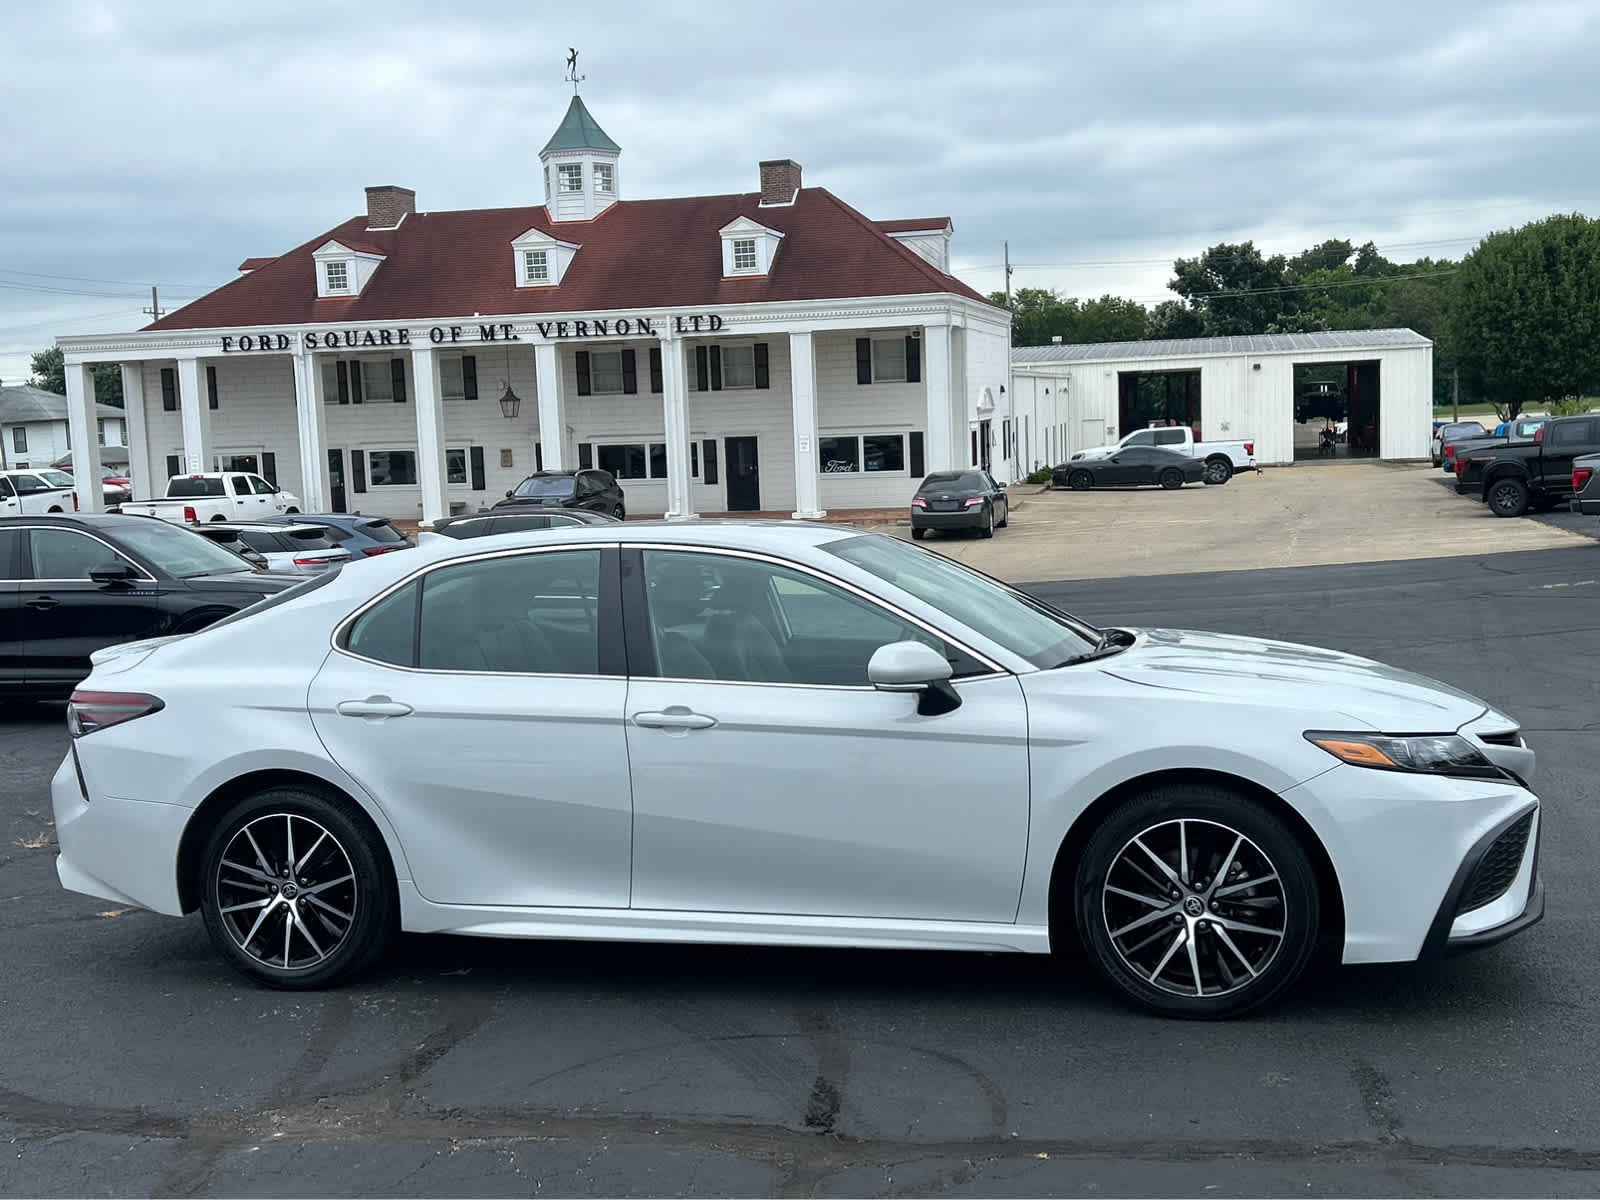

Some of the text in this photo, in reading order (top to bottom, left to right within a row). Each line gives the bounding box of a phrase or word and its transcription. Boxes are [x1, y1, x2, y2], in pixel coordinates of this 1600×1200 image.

[221, 314, 723, 352] FORD SQUARE OF MT. VERNON, LTD
[824, 459, 854, 472] Ford
